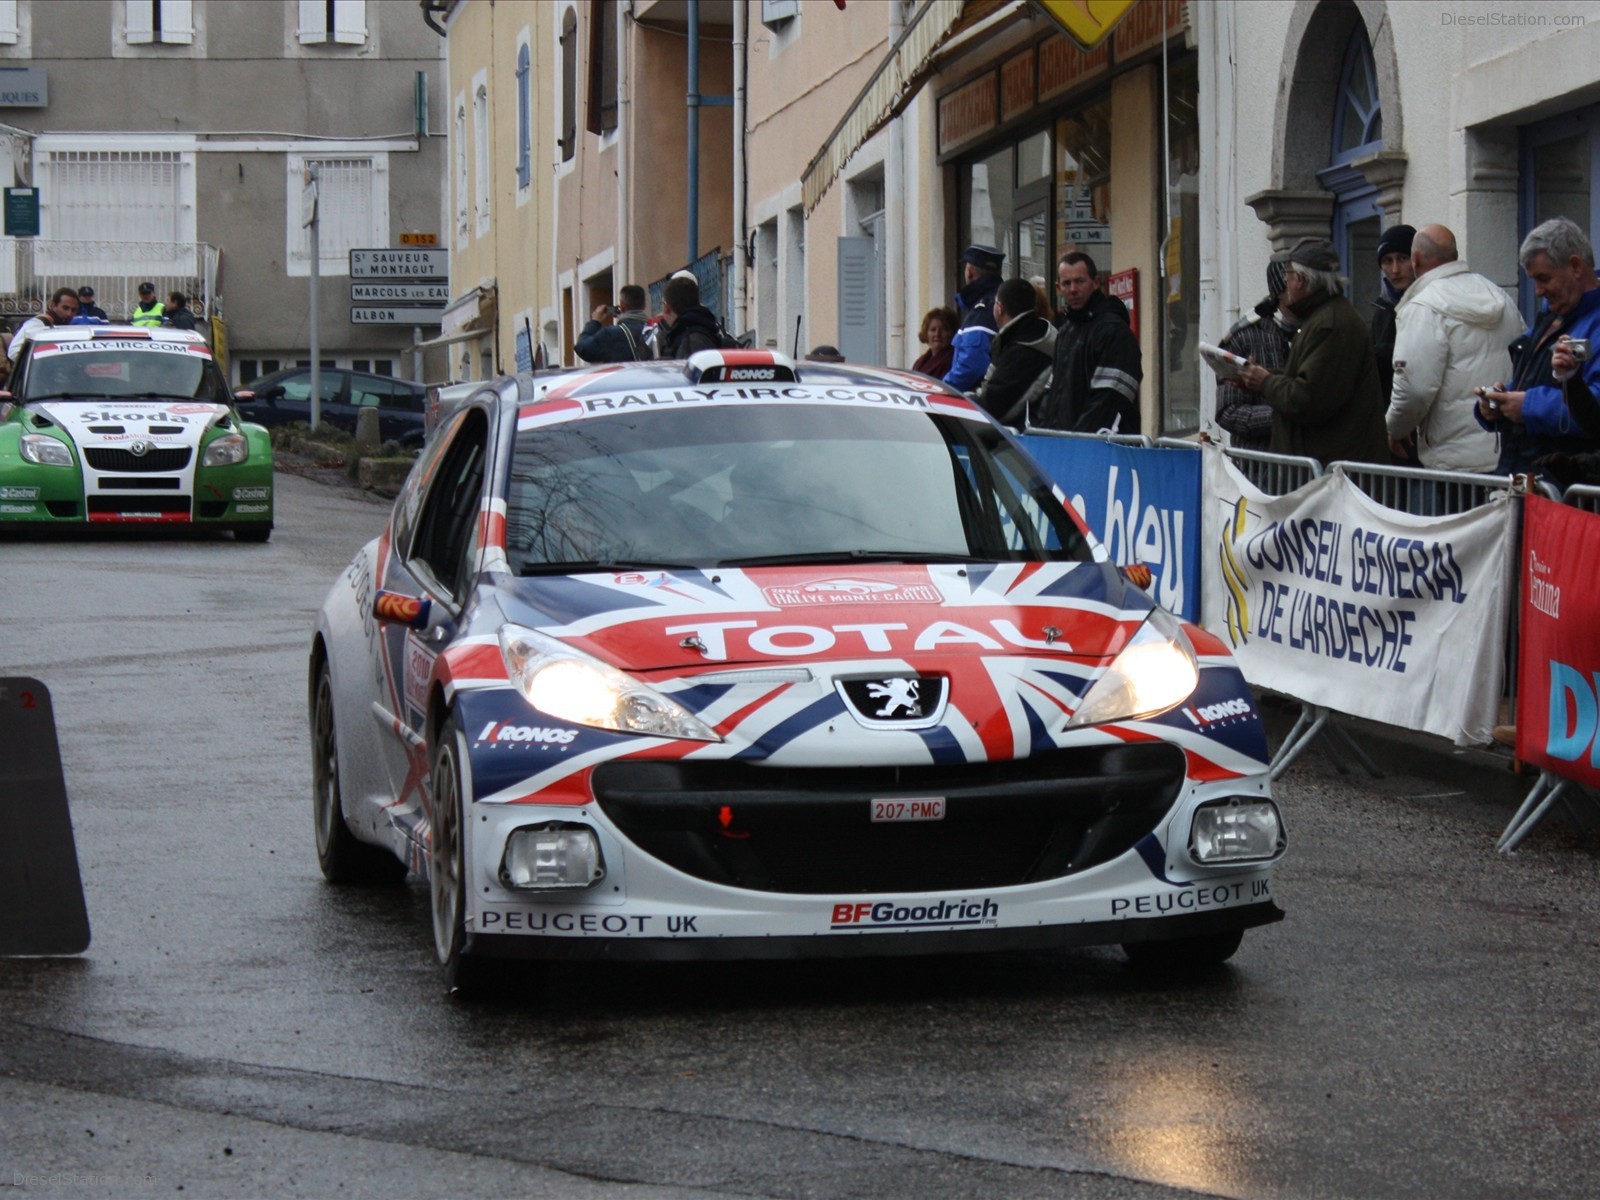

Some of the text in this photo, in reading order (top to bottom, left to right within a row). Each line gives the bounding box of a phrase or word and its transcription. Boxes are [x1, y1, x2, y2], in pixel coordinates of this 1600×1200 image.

[416, 234, 434, 244] 152
[372, 254, 429, 262] SAUVEUR
[370, 265, 434, 274] MONTAGUT
[355, 288, 407, 297] MARCOLS
[428, 288, 449, 297] EAU
[355, 311, 395, 320] ALBON
[60, 342, 188, 353] RALLY-IRC.COM
[585, 388, 927, 411] RALLY-IRC.COM
[1247, 518, 1468, 604] CONSEIL GENERAL
[772, 589, 934, 605] RALLYE MONTE CARLO
[1258, 580, 1416, 673] DE L'ARDECHE
[665, 620, 1073, 661] TOTAL
[20, 690, 37, 709] 2
[1545, 658, 1600, 770] D
[875, 801, 941, 819] 207-PMC
[1111, 879, 1269, 916] PEUGEOT UK
[831, 899, 999, 924] BFGoodrich
[482, 911, 698, 933] PEUGEOT UK
